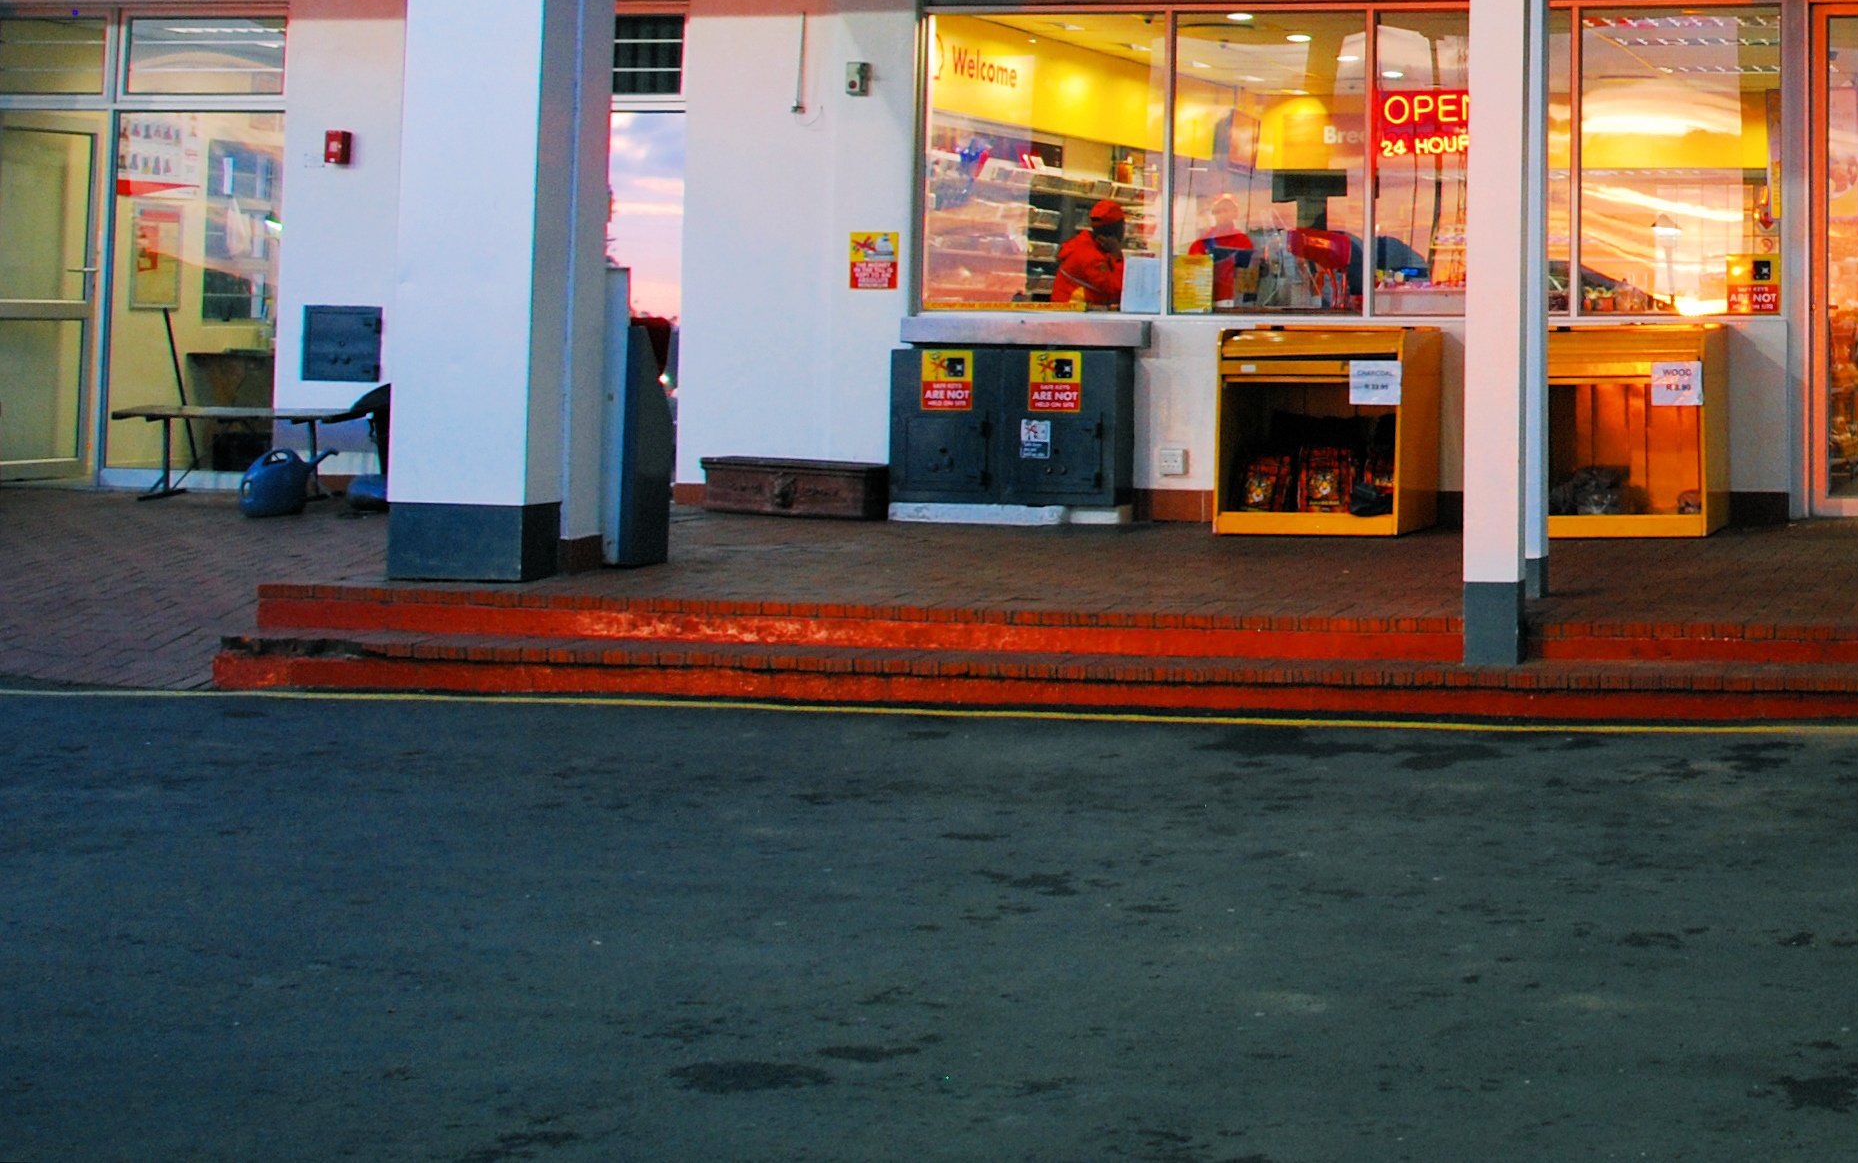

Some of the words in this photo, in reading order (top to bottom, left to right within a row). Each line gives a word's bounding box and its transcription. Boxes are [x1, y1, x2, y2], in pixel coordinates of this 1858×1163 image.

[952, 45, 1017, 88] Welcome
[1381, 139, 1406, 157] 24
[1415, 135, 1470, 154] HOUR
[1753, 294, 1776, 302] NOT
[925, 390, 945, 399] ARE
[946, 390, 970, 399] NOT
[1032, 391, 1052, 400] ARE
[1054, 391, 1078, 400] NOT
